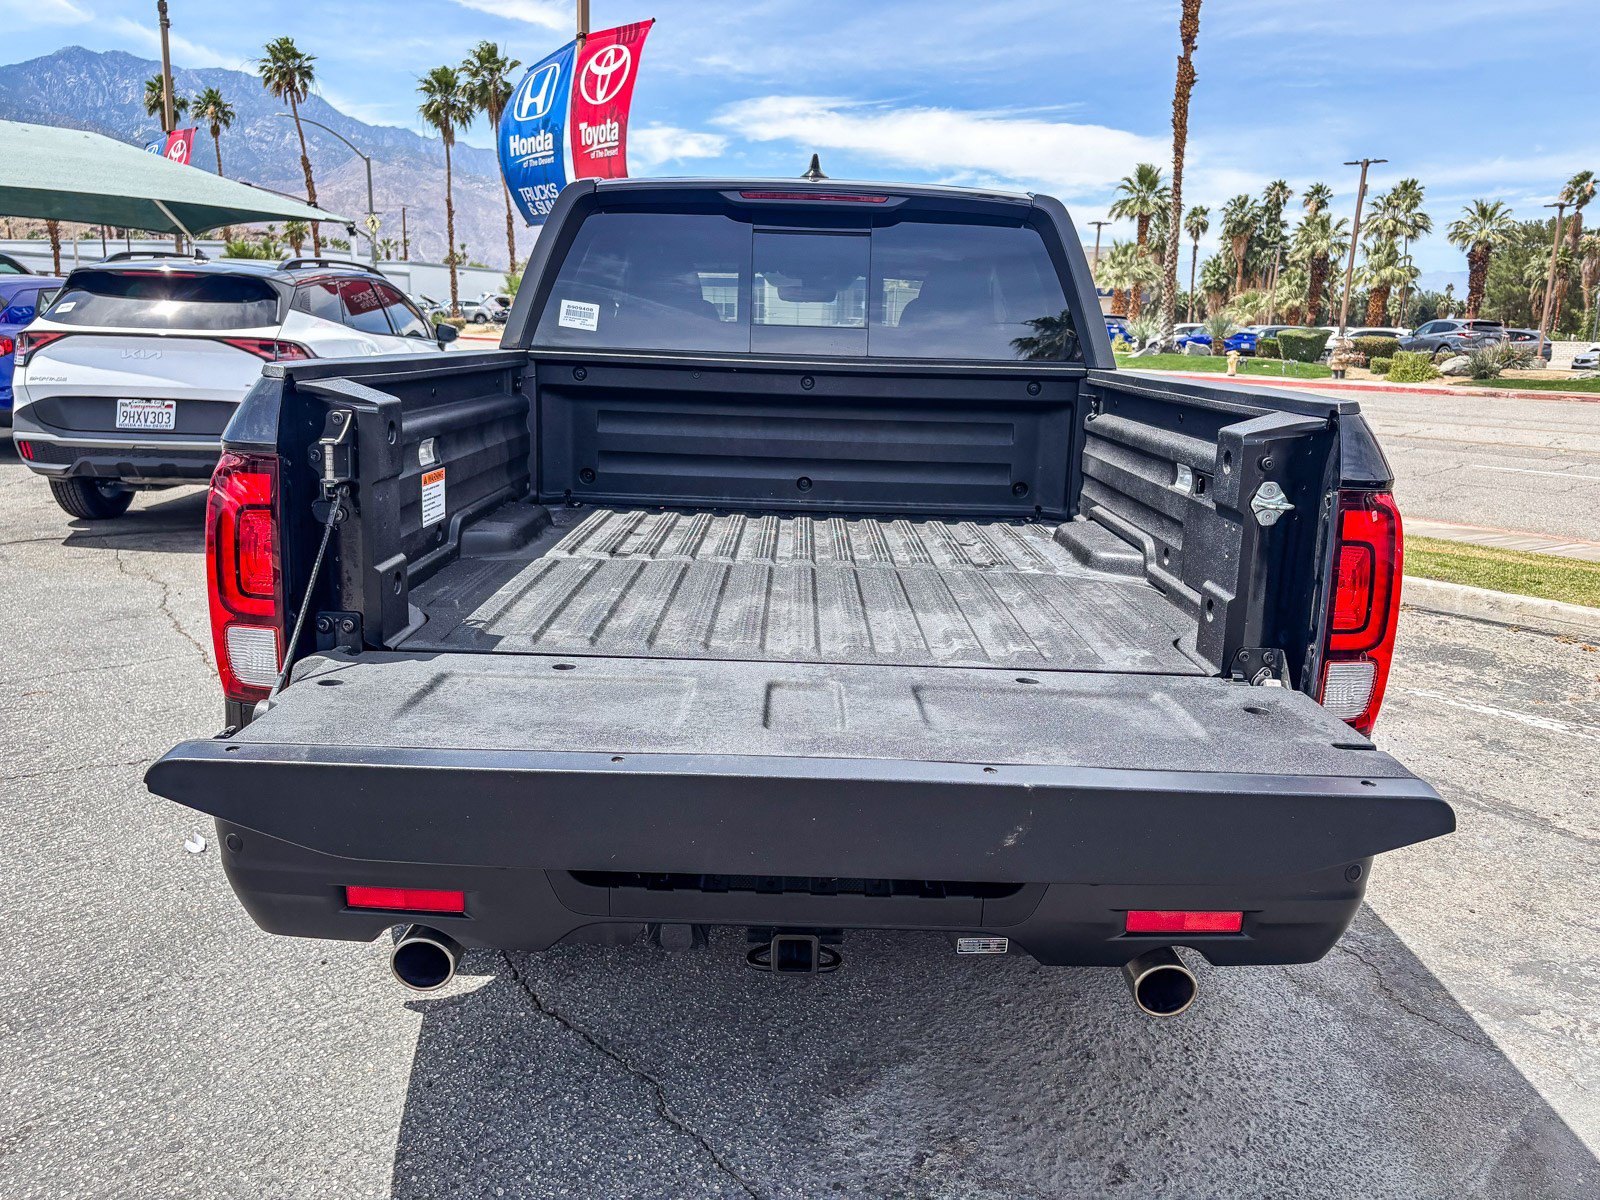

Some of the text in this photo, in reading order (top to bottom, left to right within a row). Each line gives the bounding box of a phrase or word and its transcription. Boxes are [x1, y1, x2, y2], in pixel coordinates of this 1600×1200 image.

[579, 118, 619, 147] Toyota
[509, 129, 554, 157] Honda
[596, 150, 604, 158] The
[604, 148, 619, 157] Desert
[523, 156, 554, 168] of The Desert
[518, 183, 559, 202] TRUCKS
[527, 202, 538, 215] &
[121, 348, 162, 359] KIA
[121, 410, 171, 424] 9HXV303
